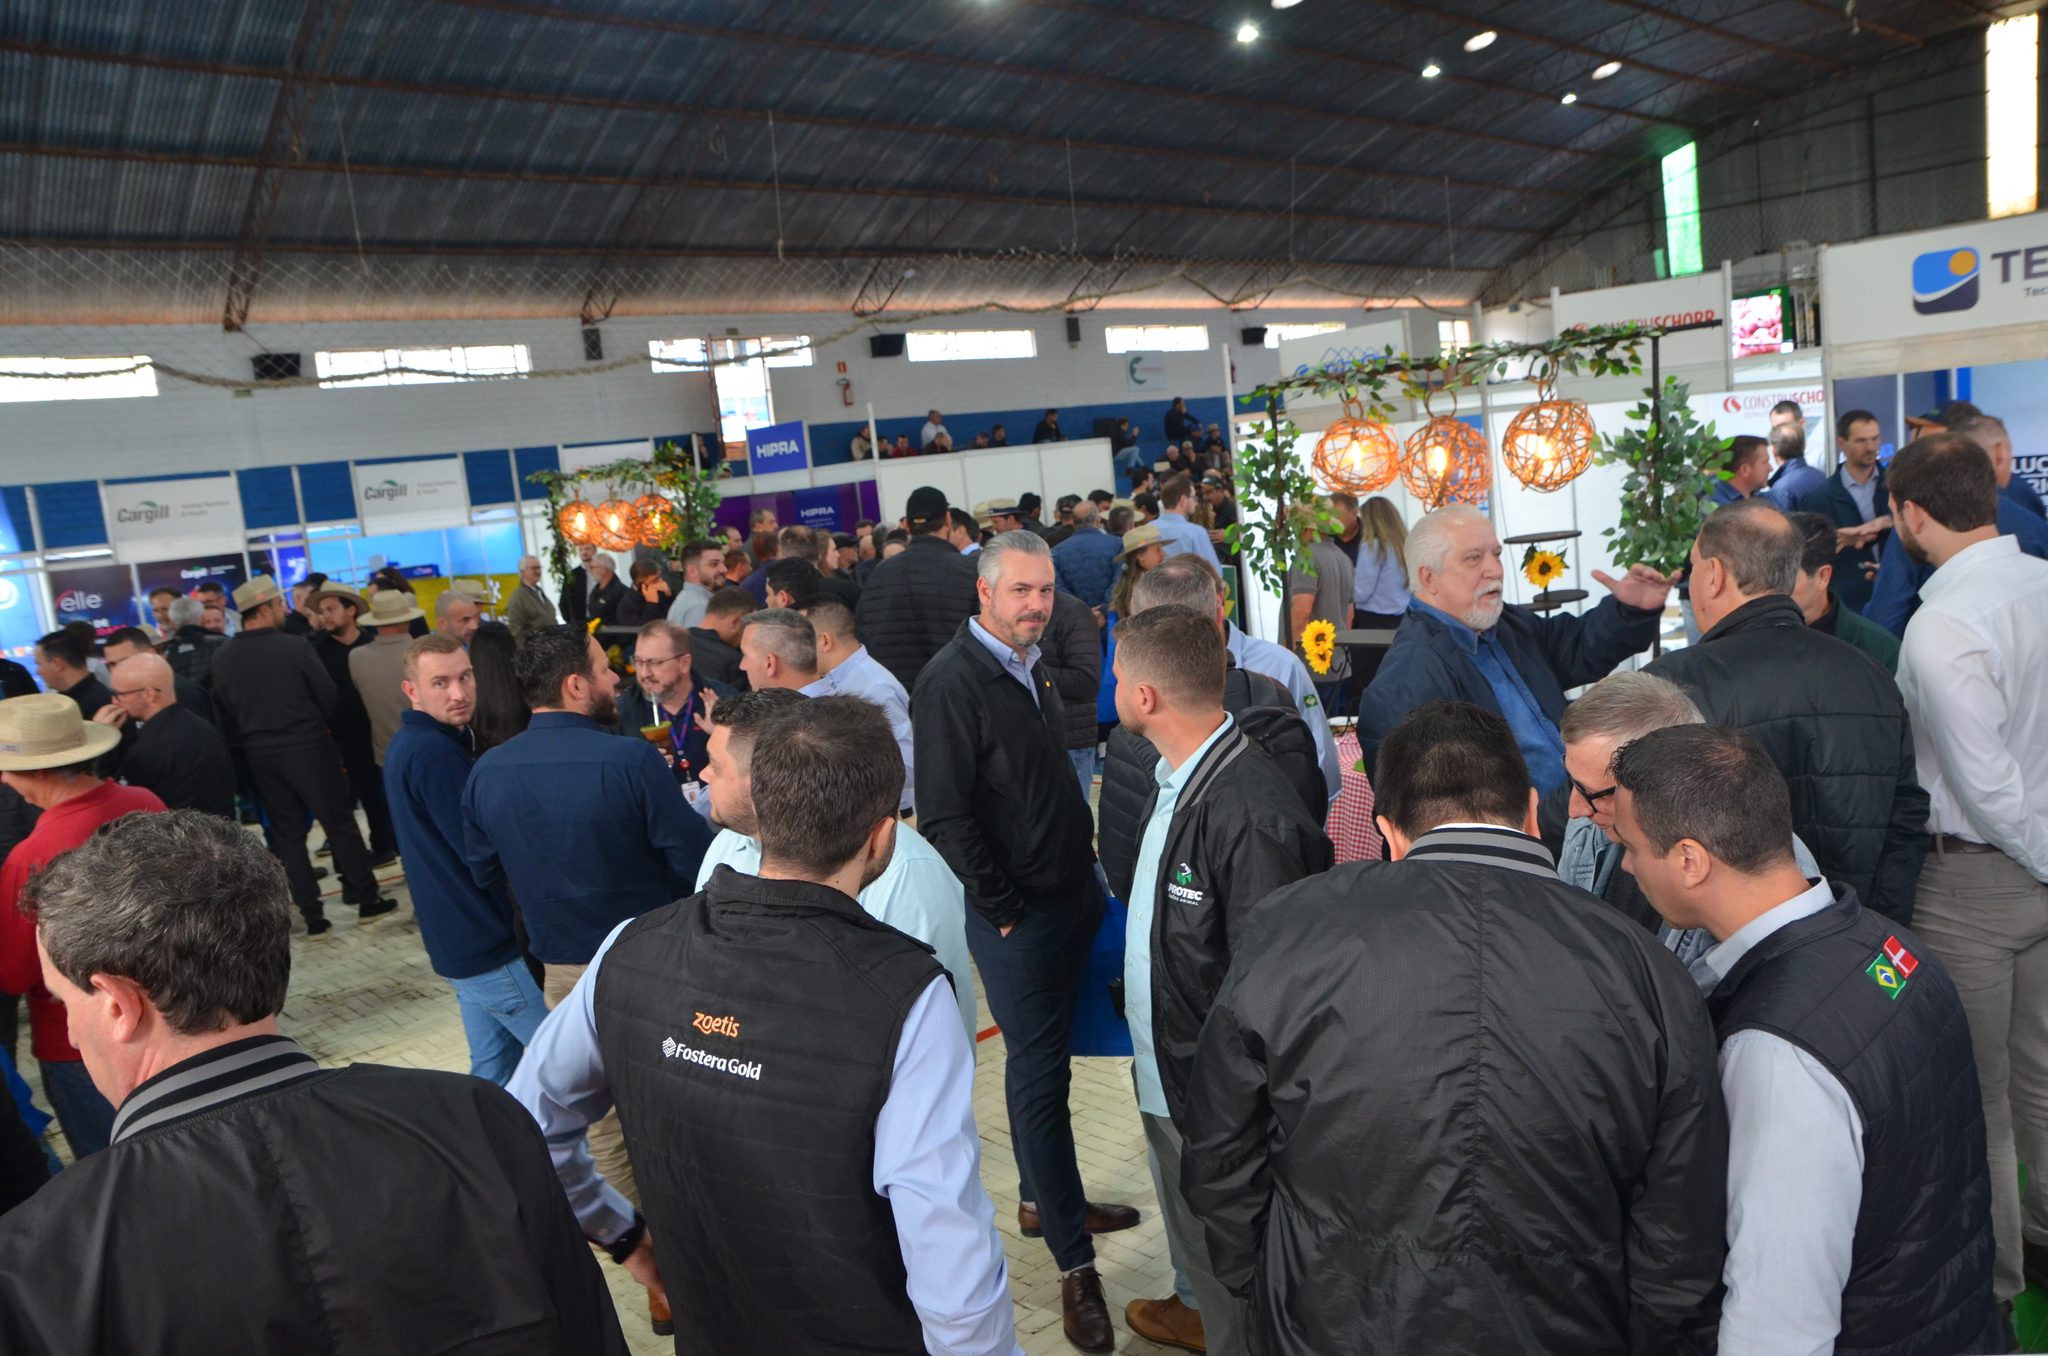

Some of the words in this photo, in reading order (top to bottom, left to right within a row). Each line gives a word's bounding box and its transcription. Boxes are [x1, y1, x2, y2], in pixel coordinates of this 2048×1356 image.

[1990, 245, 2048, 283] TE
[756, 440, 799, 458] HIPRA
[363, 483, 408, 501] Cargill
[117, 505, 169, 523] Cargill
[800, 506, 834, 518] HIPRA
[692, 1012, 740, 1038] zoetis
[675, 1043, 727, 1072] Fostera
[727, 1059, 762, 1081] Gold
